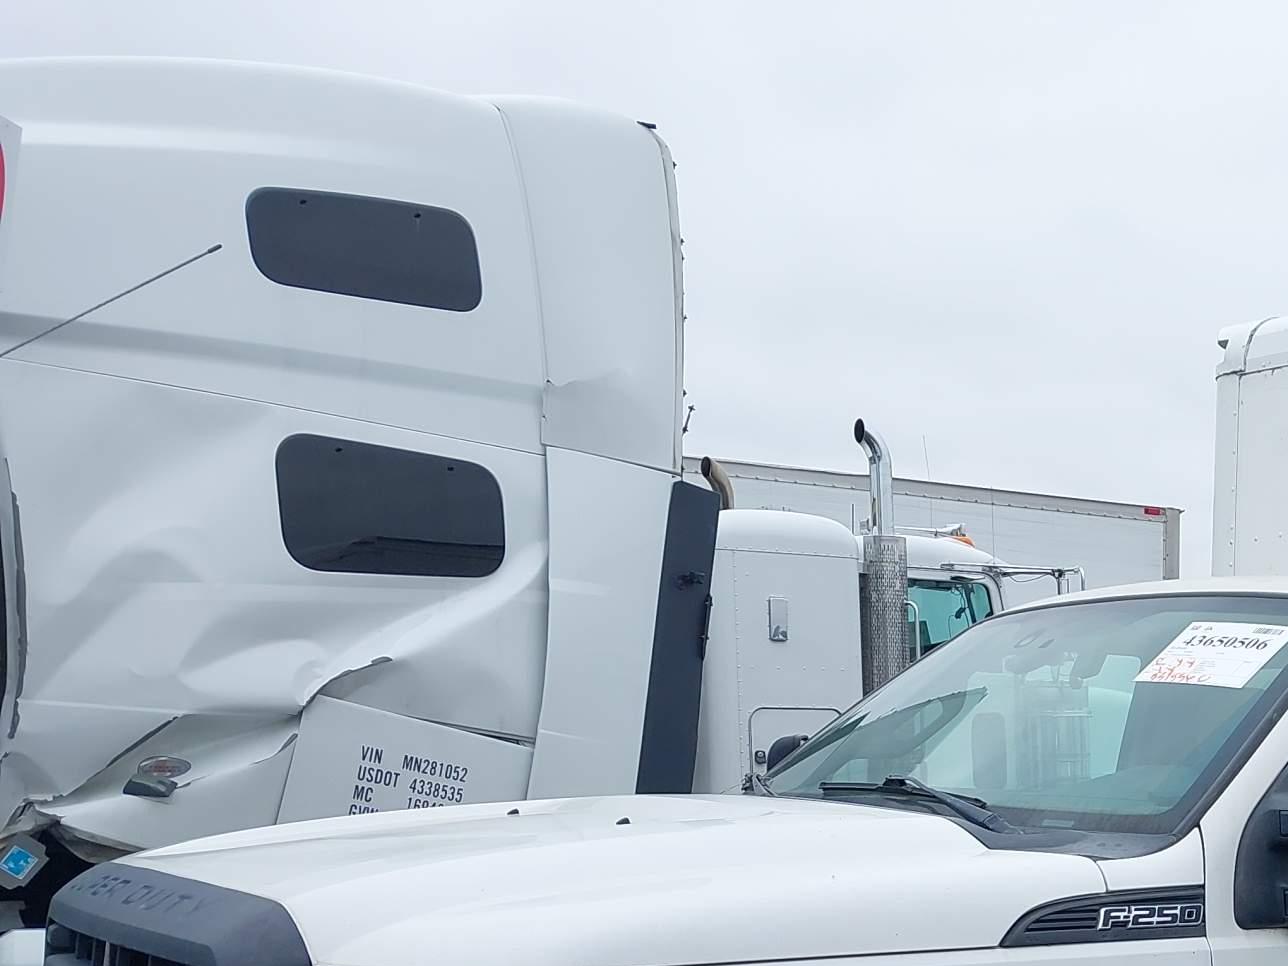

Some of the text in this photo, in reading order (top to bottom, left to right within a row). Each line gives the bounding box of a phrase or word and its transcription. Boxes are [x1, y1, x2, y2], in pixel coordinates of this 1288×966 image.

[1183, 634, 1274, 651] 43650506
[361, 745, 468, 783] VIN MN281052
[352, 784, 374, 803] MC
[357, 765, 464, 803] USDOT 4338535
[1097, 904, 1204, 931] F-250
